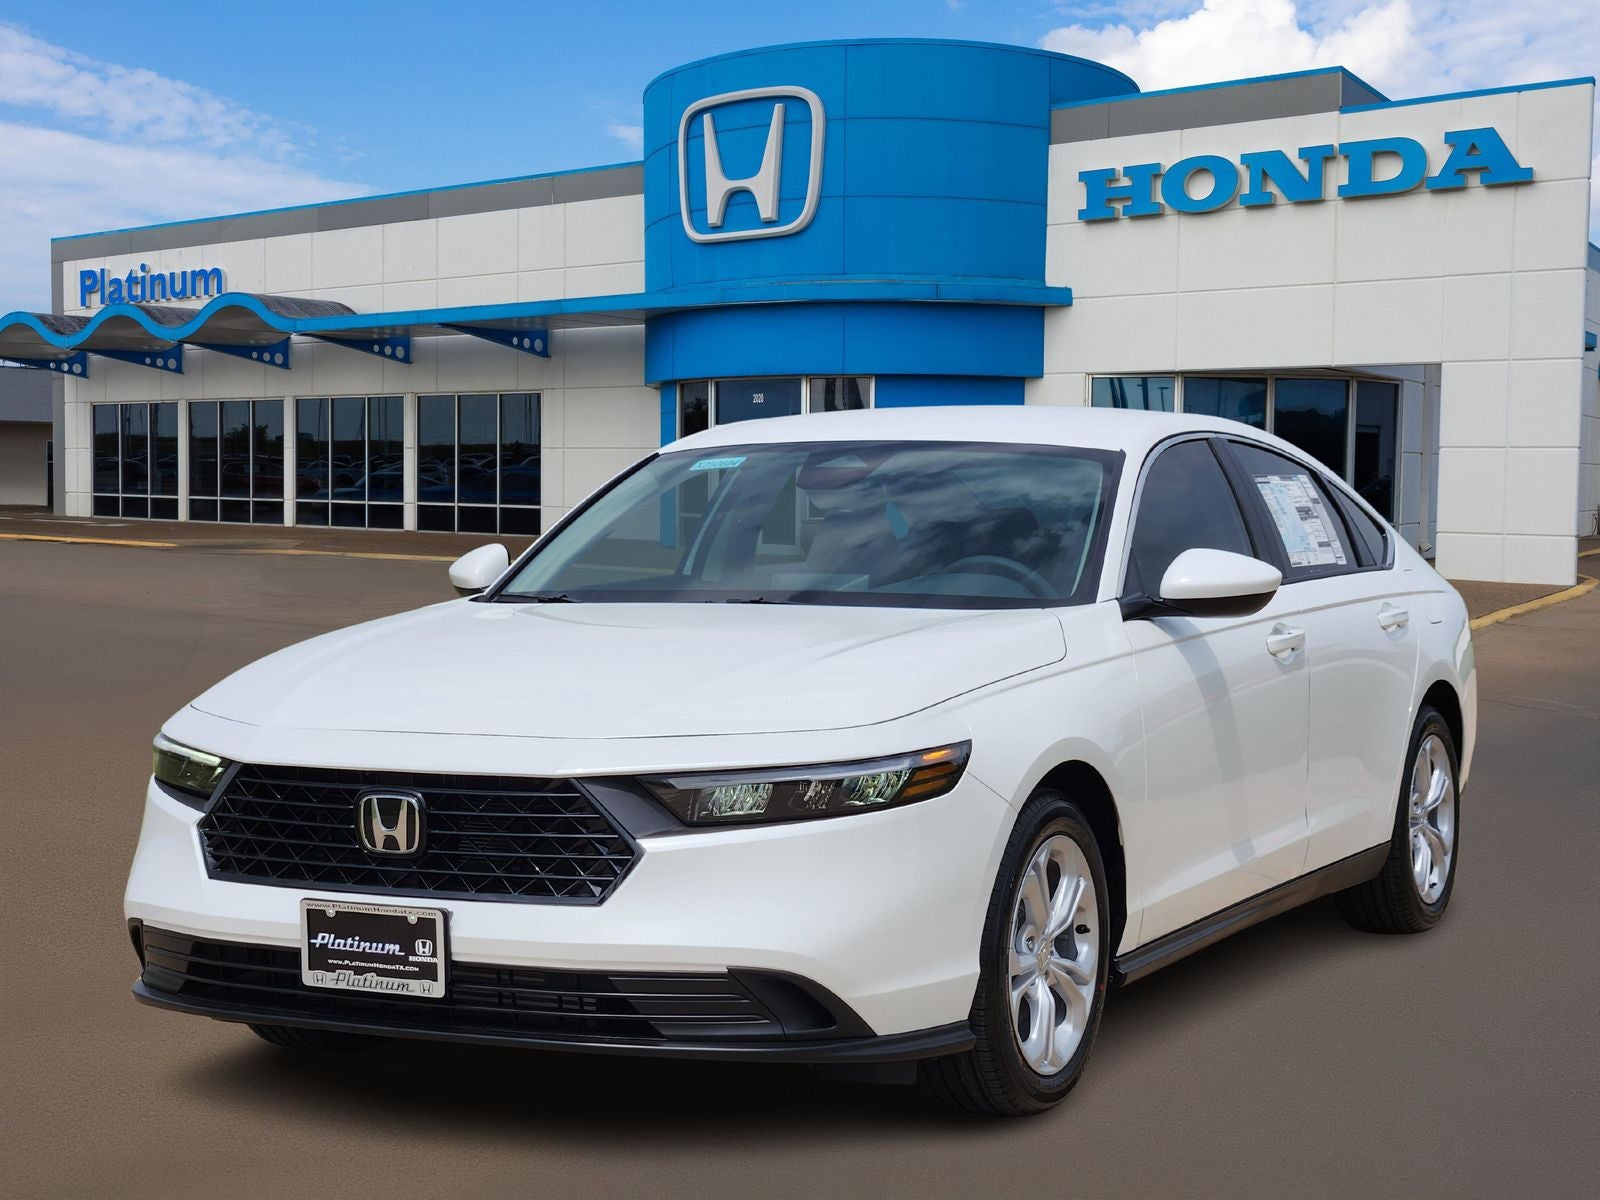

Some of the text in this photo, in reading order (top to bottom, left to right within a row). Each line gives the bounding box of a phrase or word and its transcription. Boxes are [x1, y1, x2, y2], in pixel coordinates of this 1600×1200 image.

[1078, 126, 1534, 221] HONDA
[80, 263, 225, 307] Platinum
[310, 932, 405, 956] Platinum
[408, 955, 438, 963] HONDA
[330, 972, 416, 993] Platinum
